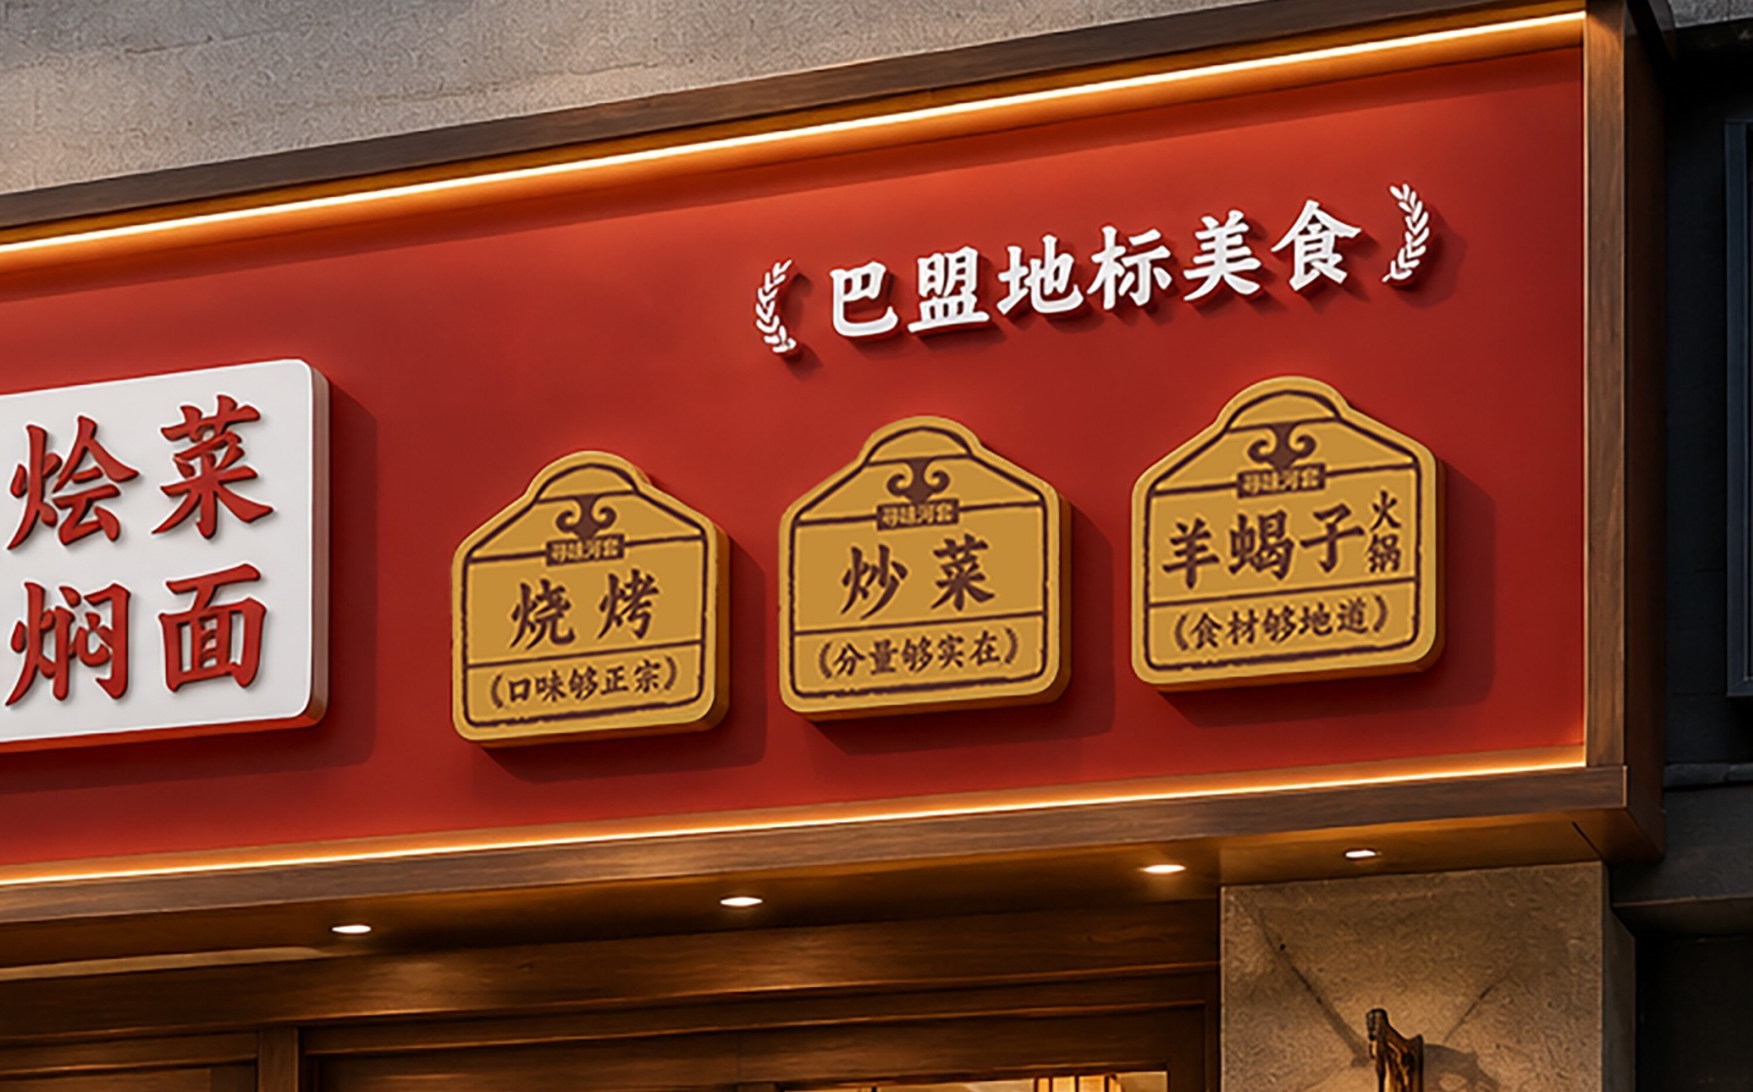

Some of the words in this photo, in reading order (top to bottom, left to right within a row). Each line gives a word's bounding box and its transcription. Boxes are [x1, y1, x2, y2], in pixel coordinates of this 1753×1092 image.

[830, 200, 1361, 337] 巴盟地标美食
[1162, 503, 1366, 590] 羊蝎子
[1368, 490, 1402, 573] 火锅
[510, 568, 660, 650] 烧烤
[840, 534, 995, 620] 炒菜
